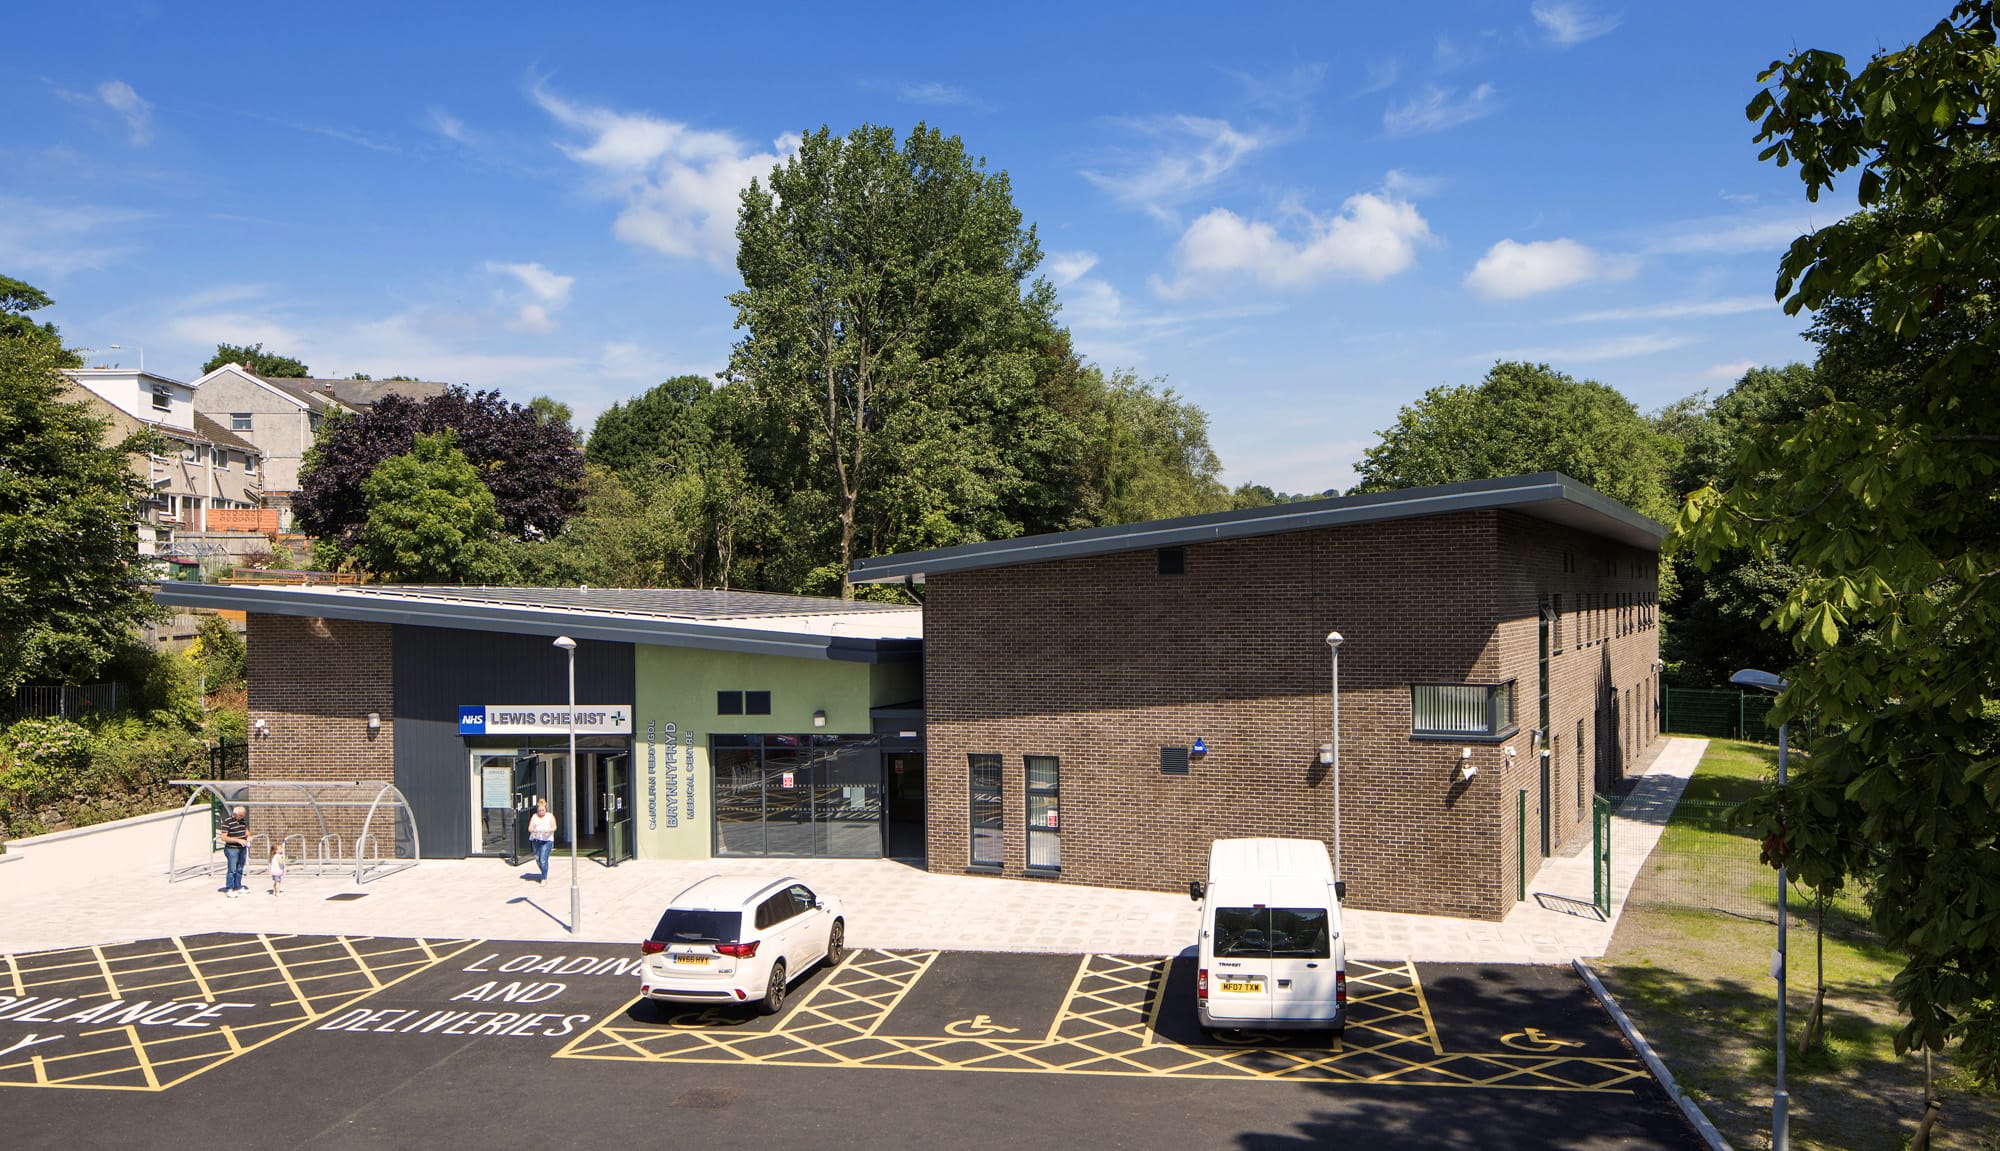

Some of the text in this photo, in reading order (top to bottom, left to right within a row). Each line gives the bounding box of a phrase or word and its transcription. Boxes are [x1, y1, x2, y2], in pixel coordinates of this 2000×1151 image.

[462, 715, 483, 725] NHS
[490, 712, 536, 725] LEWIS
[665, 722, 678, 828] BRYNHYFRYD
[685, 730, 694, 820] MEDICAL CENTRE
[462, 953, 642, 977] LOADIN
[450, 981, 567, 1003] AND
[1223, 983, 1259, 991] MF07 TXW
[316, 1008, 590, 1037] DELIVERIES
